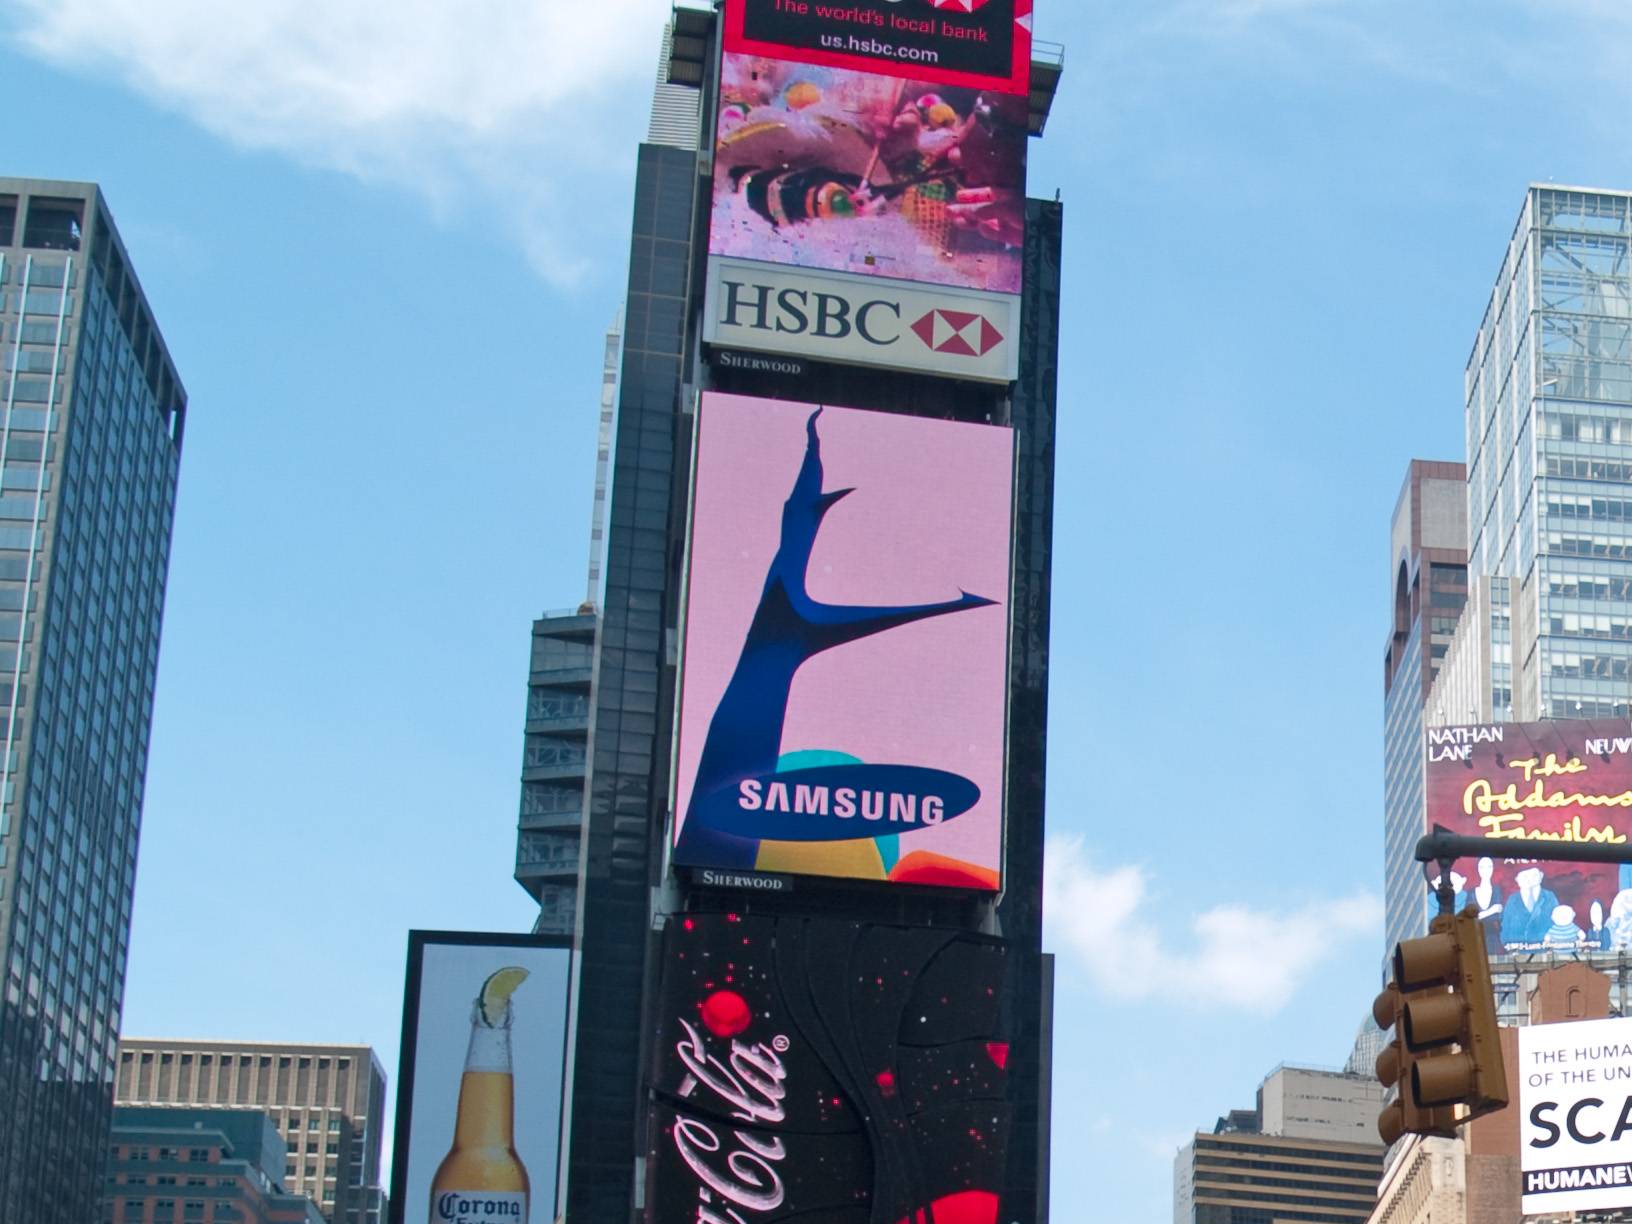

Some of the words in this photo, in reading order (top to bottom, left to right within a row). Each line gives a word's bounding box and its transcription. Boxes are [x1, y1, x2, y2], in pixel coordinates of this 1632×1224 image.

[774, 0, 808, 14] The
[816, 4, 884, 27] world's
[890, 13, 936, 34] local
[942, 21, 988, 42] bank
[820, 32, 938, 63] us.hsbc.com
[719, 280, 902, 345] HSBC
[1428, 726, 1504, 745] NATHAN
[1428, 744, 1473, 762] LANE
[1509, 753, 1587, 782] The
[739, 779, 944, 826] SAMSUNG
[1478, 813, 1627, 843] Family
[1532, 1049, 1568, 1065] THE
[1528, 1072, 1553, 1087] OF
[1557, 1068, 1597, 1085] THE
[438, 1192, 520, 1220] Corona
